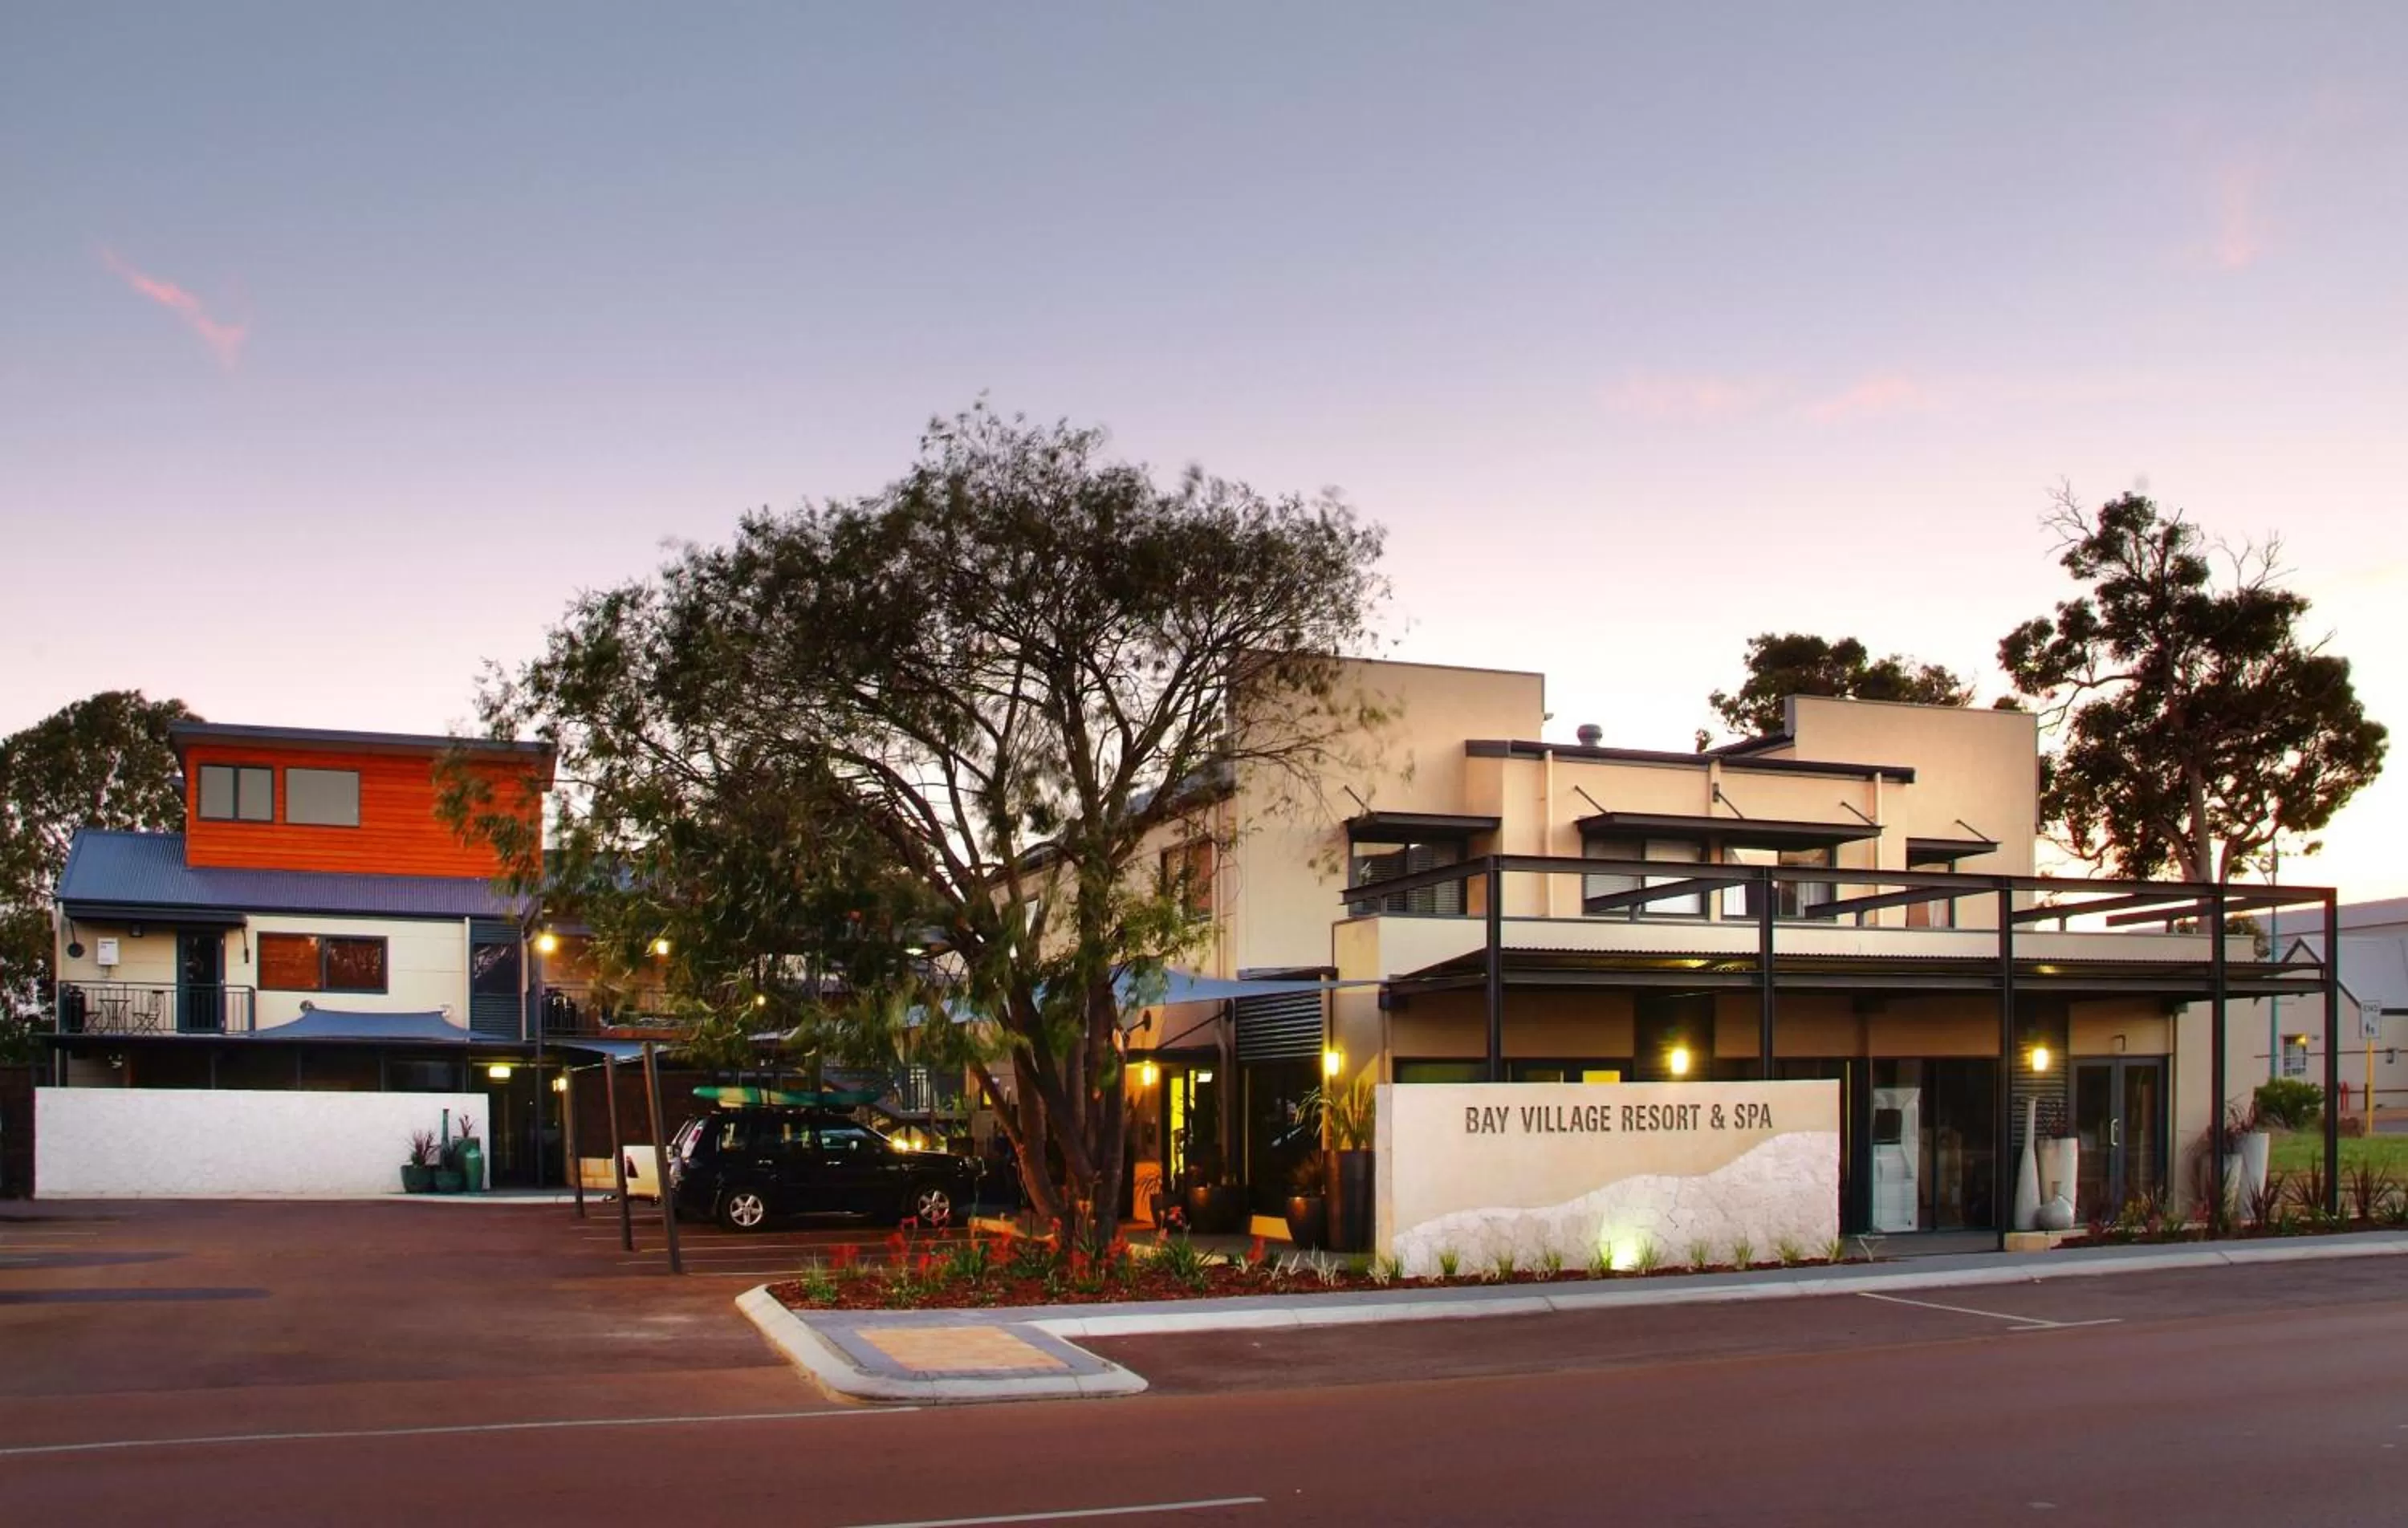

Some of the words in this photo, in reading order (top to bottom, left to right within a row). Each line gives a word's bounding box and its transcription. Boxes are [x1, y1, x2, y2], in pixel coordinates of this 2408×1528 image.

[1465, 1107, 1510, 1134] BAY
[1520, 1105, 1611, 1133] VILLAGE
[1621, 1104, 1701, 1132] RESORT
[1710, 1103, 1726, 1130] &
[1734, 1103, 1772, 1129] SPA
